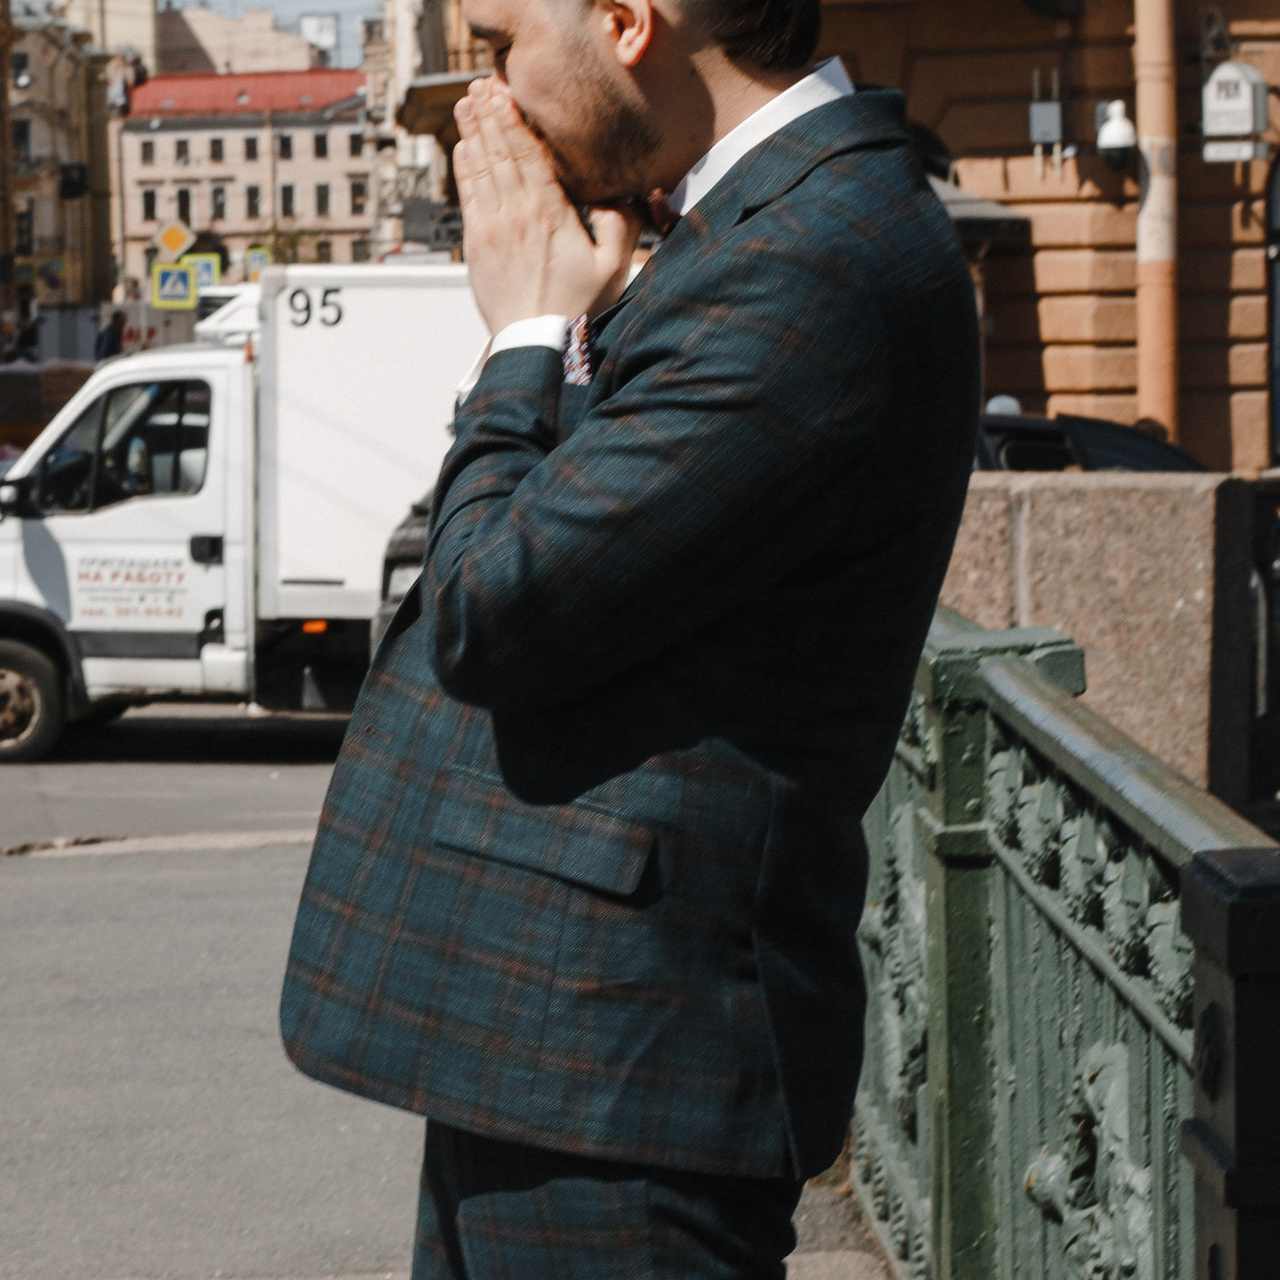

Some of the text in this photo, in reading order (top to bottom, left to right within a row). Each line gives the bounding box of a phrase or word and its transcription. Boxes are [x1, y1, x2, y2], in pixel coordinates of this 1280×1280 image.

[289, 287, 342, 326] 95
[77, 571, 185, 583] НА РАБОТУ
